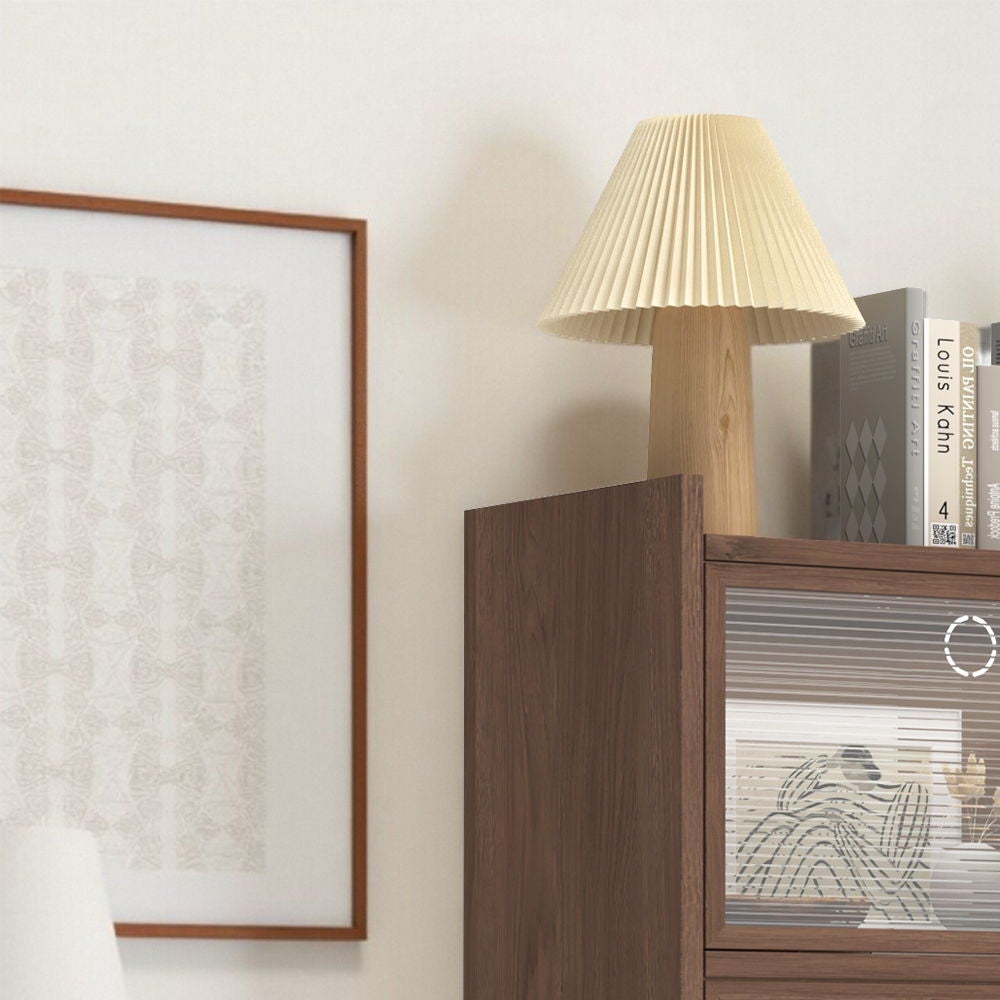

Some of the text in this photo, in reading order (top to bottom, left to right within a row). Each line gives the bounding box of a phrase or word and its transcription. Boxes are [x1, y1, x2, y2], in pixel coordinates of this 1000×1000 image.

[911, 320, 920, 456] Graffiti Art
[937, 338, 954, 454] Louis Kahn
[938, 501, 949, 520] 4
